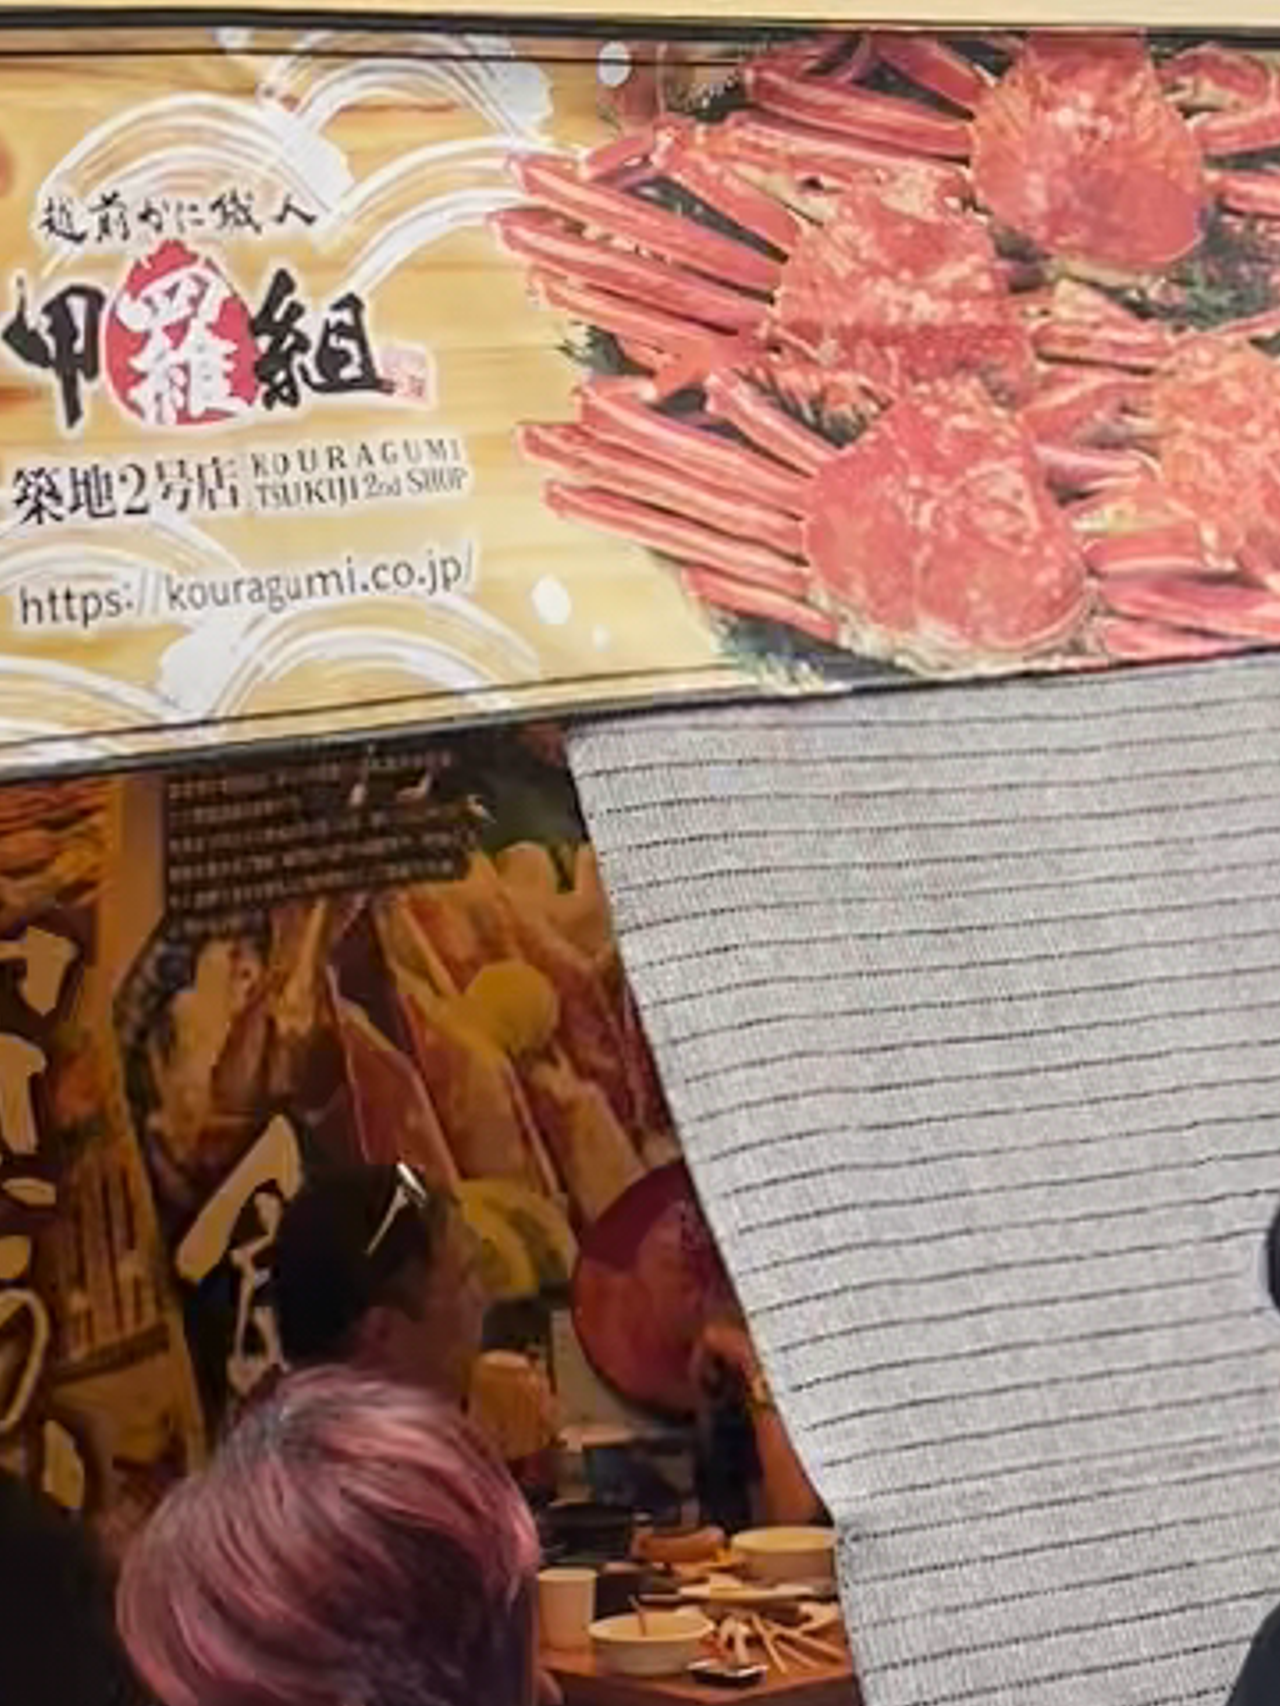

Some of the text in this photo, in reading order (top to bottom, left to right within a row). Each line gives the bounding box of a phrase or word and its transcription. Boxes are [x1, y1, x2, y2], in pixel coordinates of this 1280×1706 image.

[41, 189, 317, 244] 越前かに職人
[1, 266, 396, 429] 甲羅組
[251, 438, 461, 477] KOURAGUMI
[255, 466, 468, 510] TSUKIJI 2nd SHOP
[12, 455, 240, 525] 築地2号店
[21, 540, 475, 628] https://kouragumi.co.jp/
